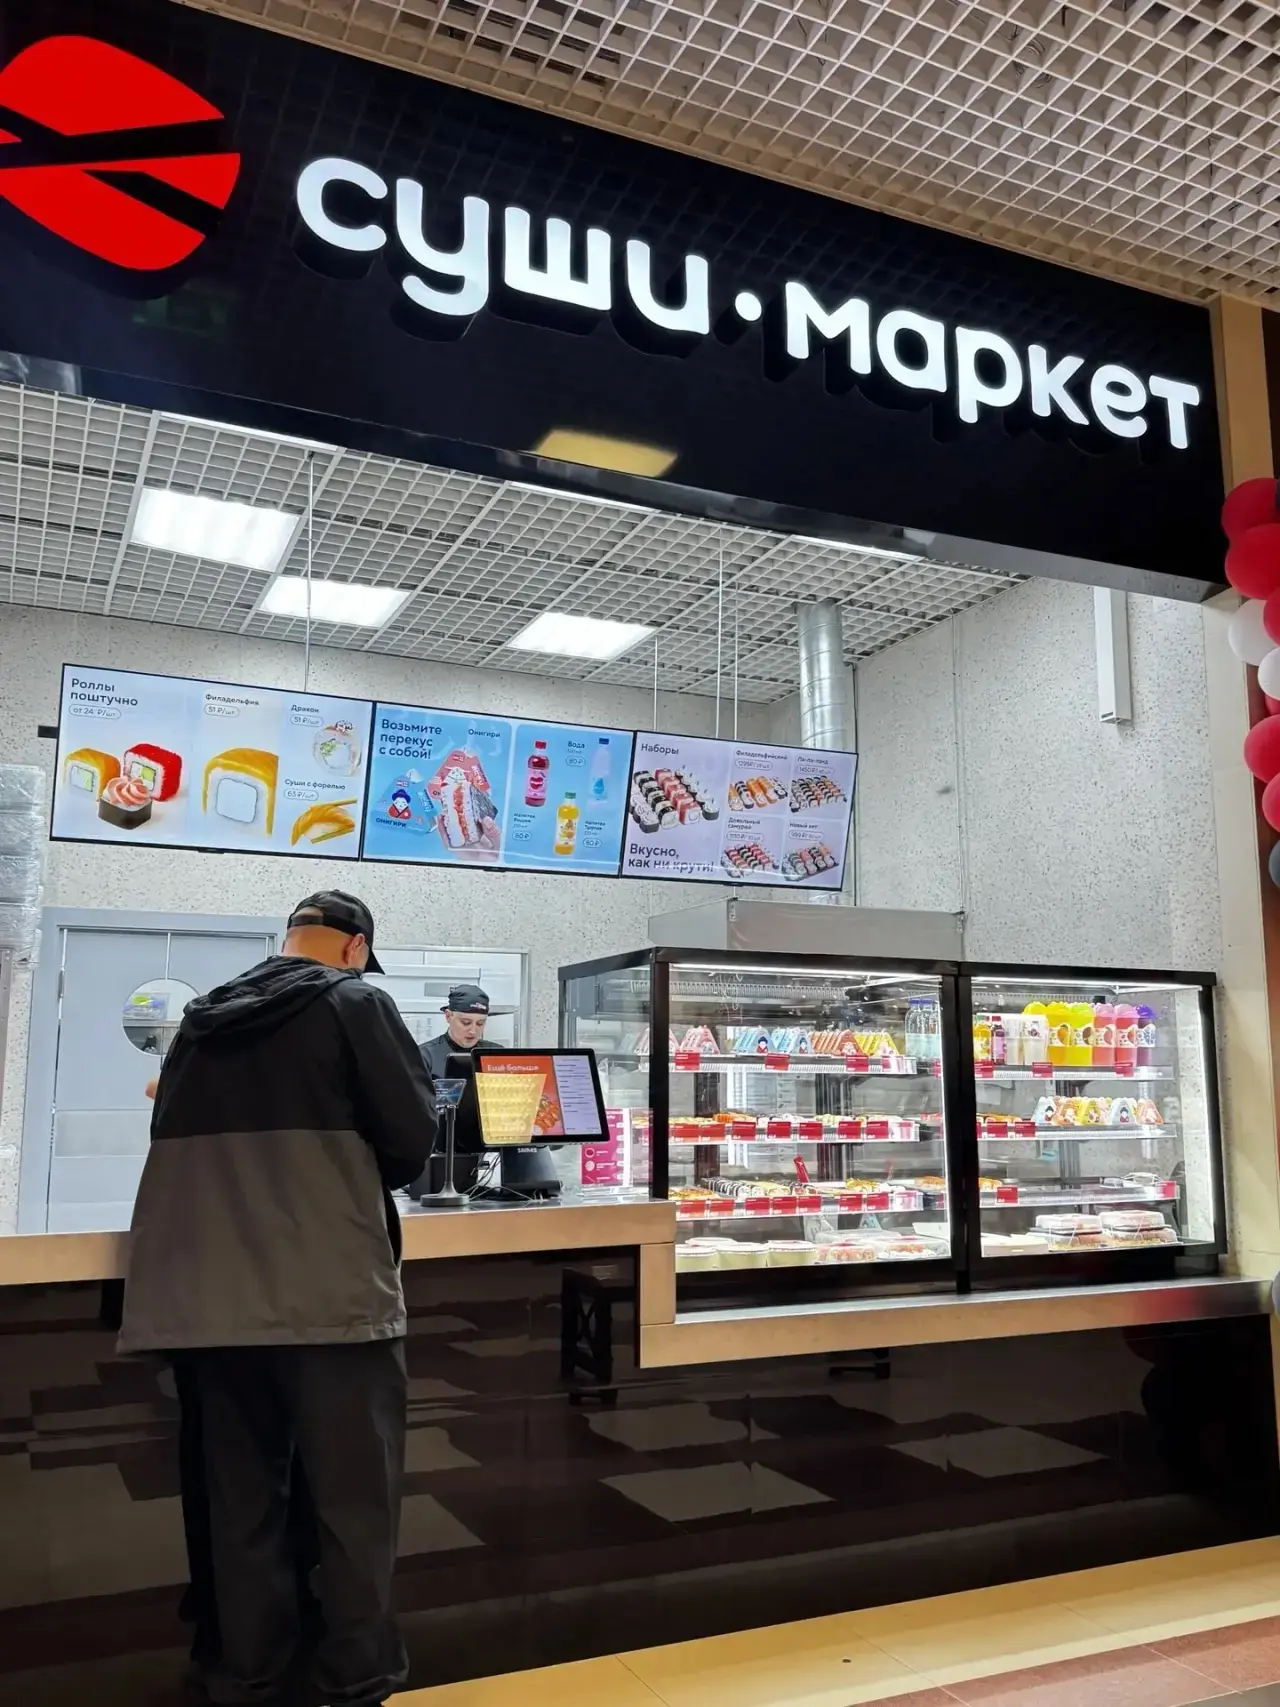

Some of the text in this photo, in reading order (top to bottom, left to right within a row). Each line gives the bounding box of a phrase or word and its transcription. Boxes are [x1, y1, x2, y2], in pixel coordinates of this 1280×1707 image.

[297, 158, 1200, 449] суши маркет
[72, 678, 115, 692] Роллы
[70, 692, 138, 706] поштучно
[205, 693, 260, 706] Филадельфия
[291, 704, 320, 713] Дракон
[381, 719, 442, 735] Возьмите
[468, 728, 501, 738] Онигири
[380, 734, 433, 749] перекус
[567, 741, 586, 749] Вода
[379, 746, 431, 759] с собой!
[641, 743, 679, 755] Наборы
[285, 778, 306, 786] Суши
[312, 781, 346, 790] форелью
[629, 843, 679, 859] Вкусно,
[628, 858, 651, 869] как
[673, 861, 714, 874] крути!
